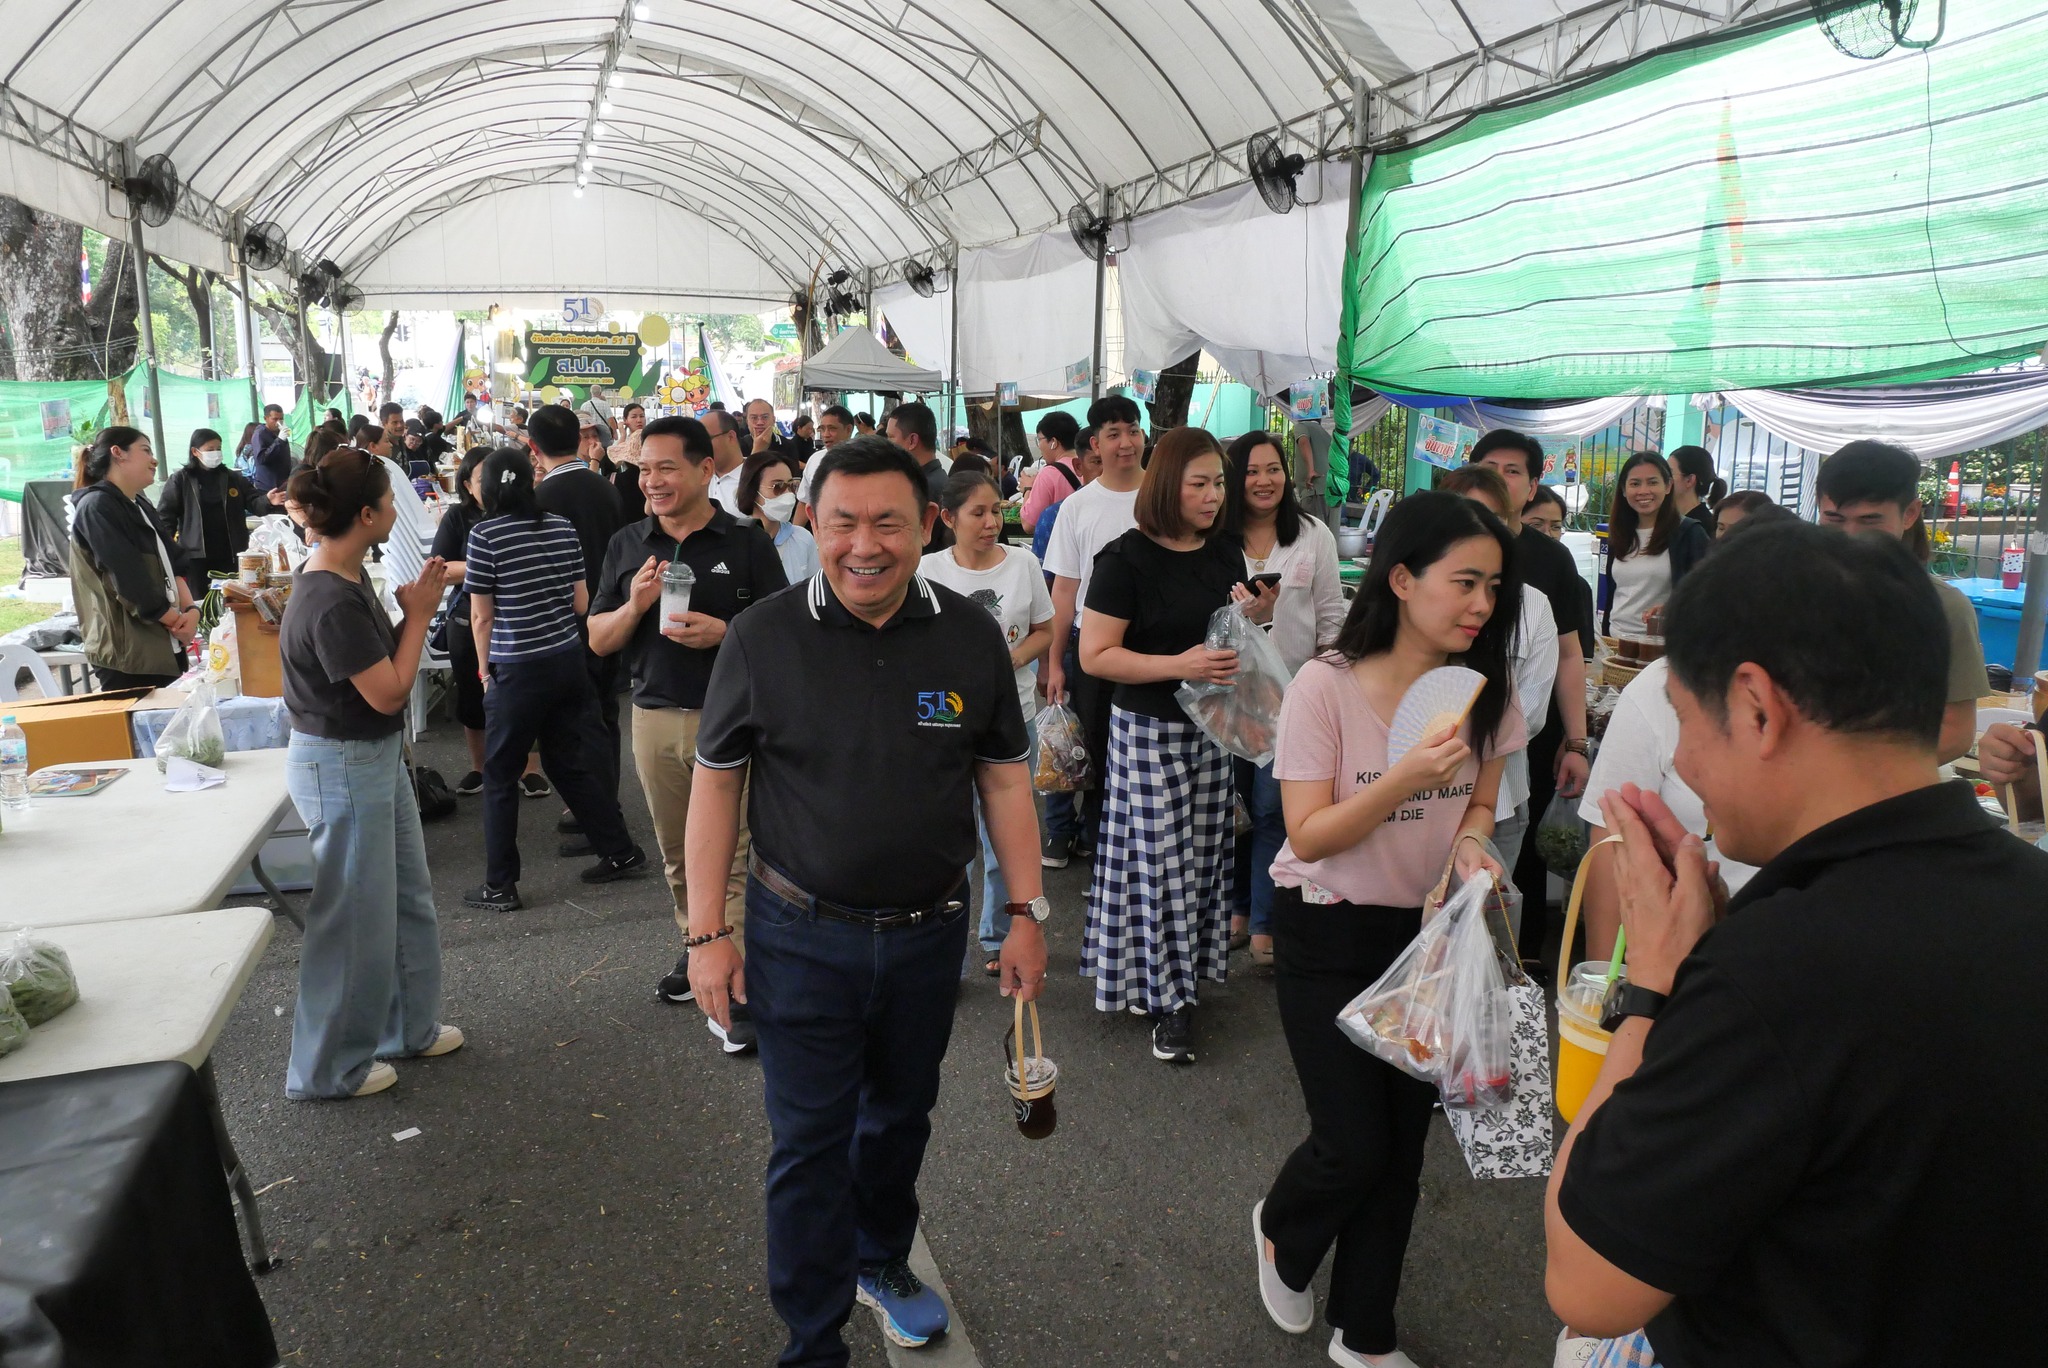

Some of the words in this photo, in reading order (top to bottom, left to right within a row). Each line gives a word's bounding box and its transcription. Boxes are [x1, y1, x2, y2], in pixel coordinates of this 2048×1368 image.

[563, 298, 590, 322] 51
[611, 336, 622, 344] 51
[557, 356, 610, 373] ส.ป.ก.
[1601, 544, 1608, 553] 23
[917, 691, 949, 719] 51
[1356, 772, 1382, 784] KIS
[1438, 783, 1473, 799] MAKE
[1401, 808, 1424, 821] DIE
